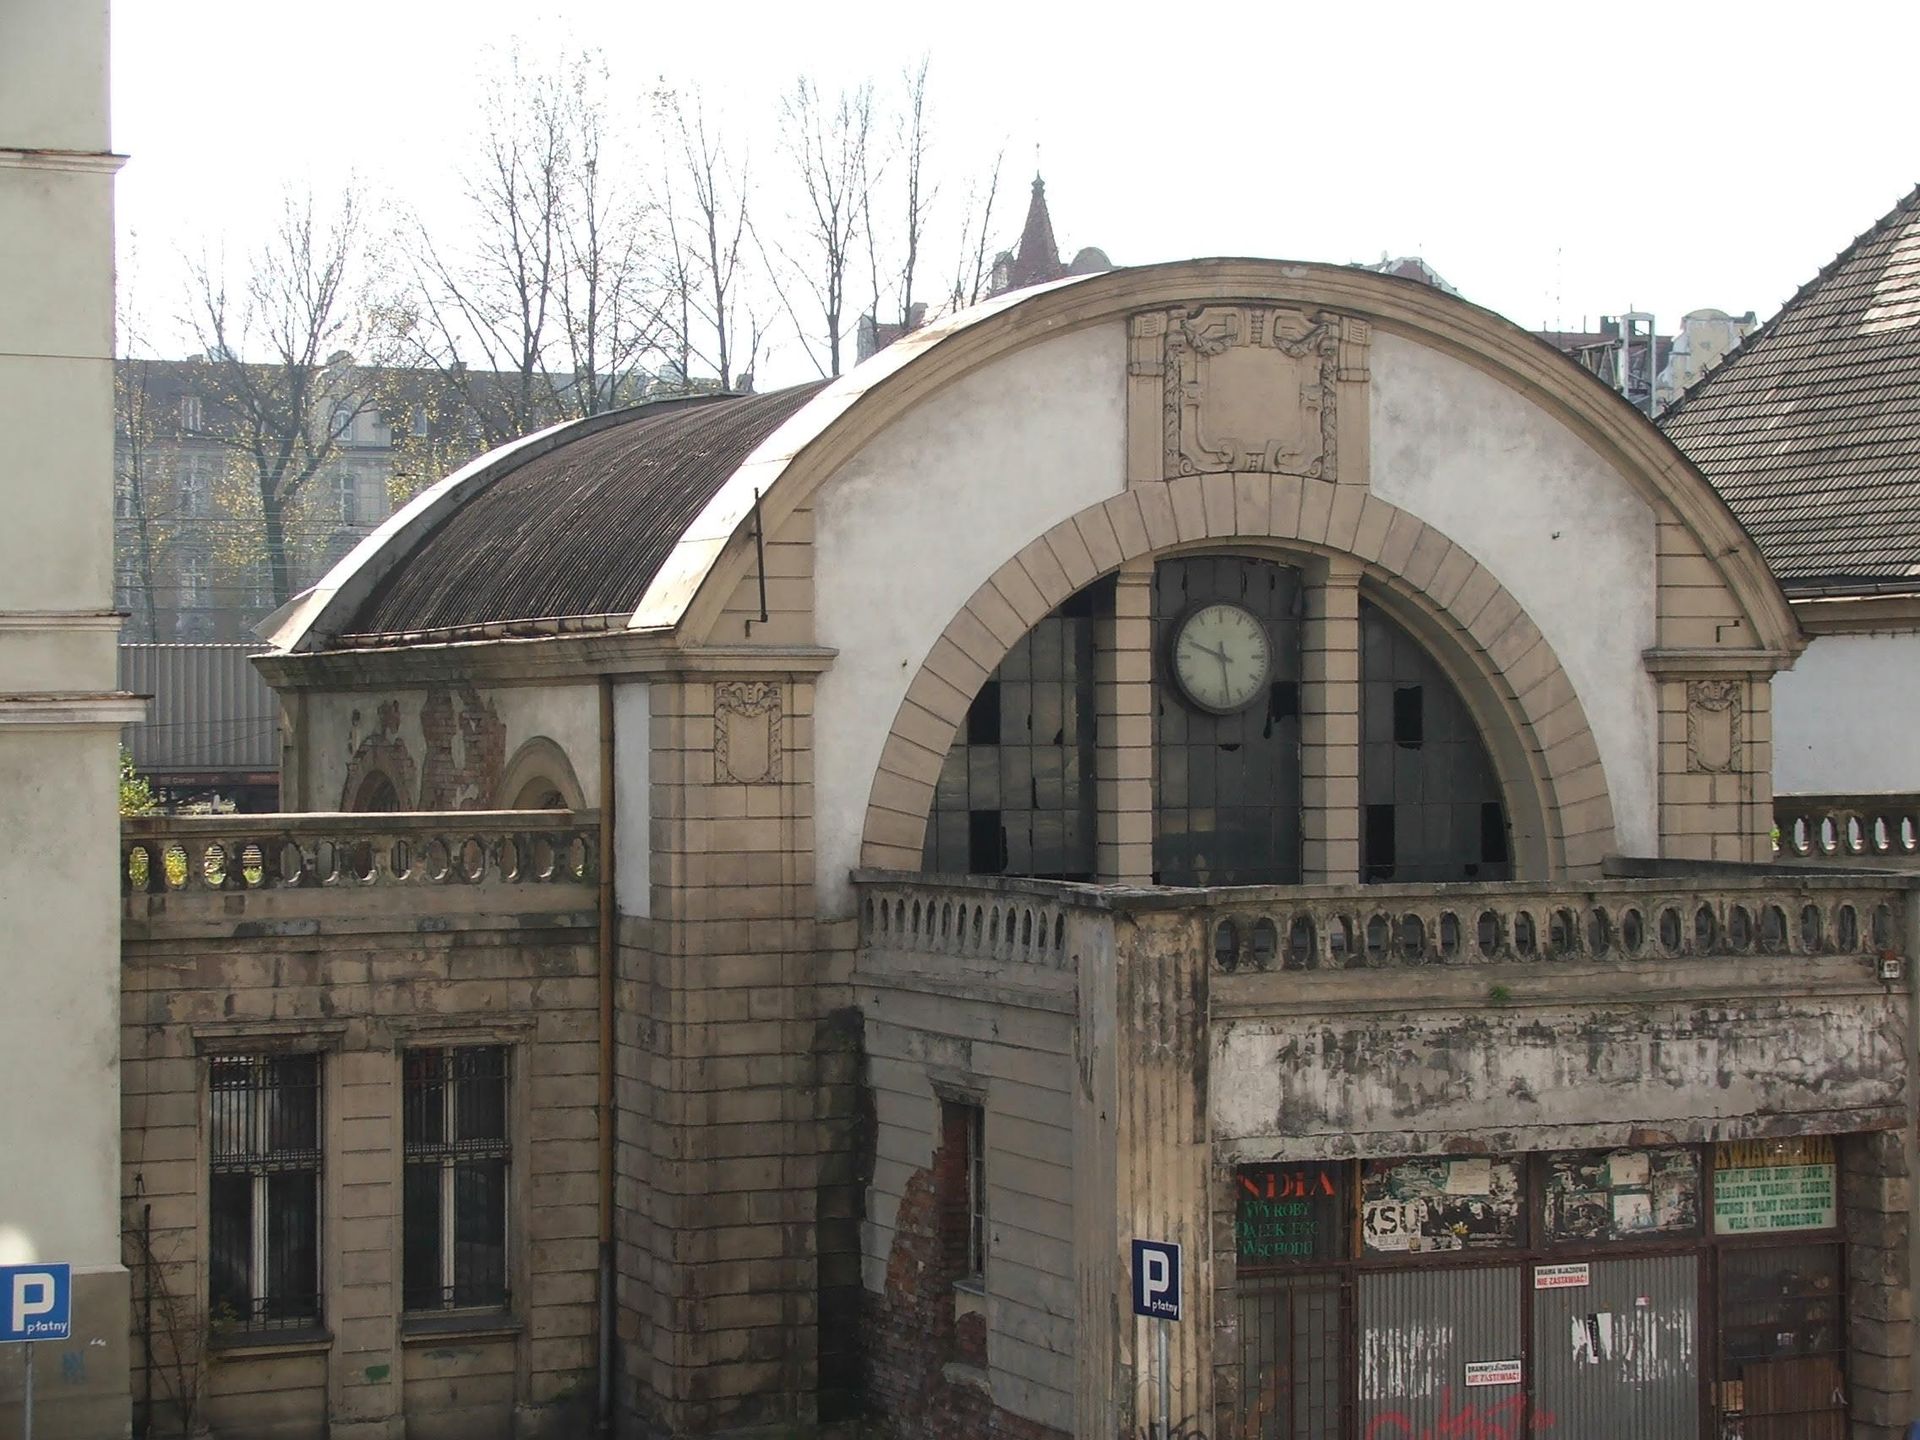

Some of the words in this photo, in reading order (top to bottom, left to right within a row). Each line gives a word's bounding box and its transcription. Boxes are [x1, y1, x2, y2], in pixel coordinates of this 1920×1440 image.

[1142, 1248, 1170, 1307] P
[12, 1273, 55, 1332] P
[1152, 1299, 1178, 1316] płatny
[27, 1320, 68, 1335] płatny
